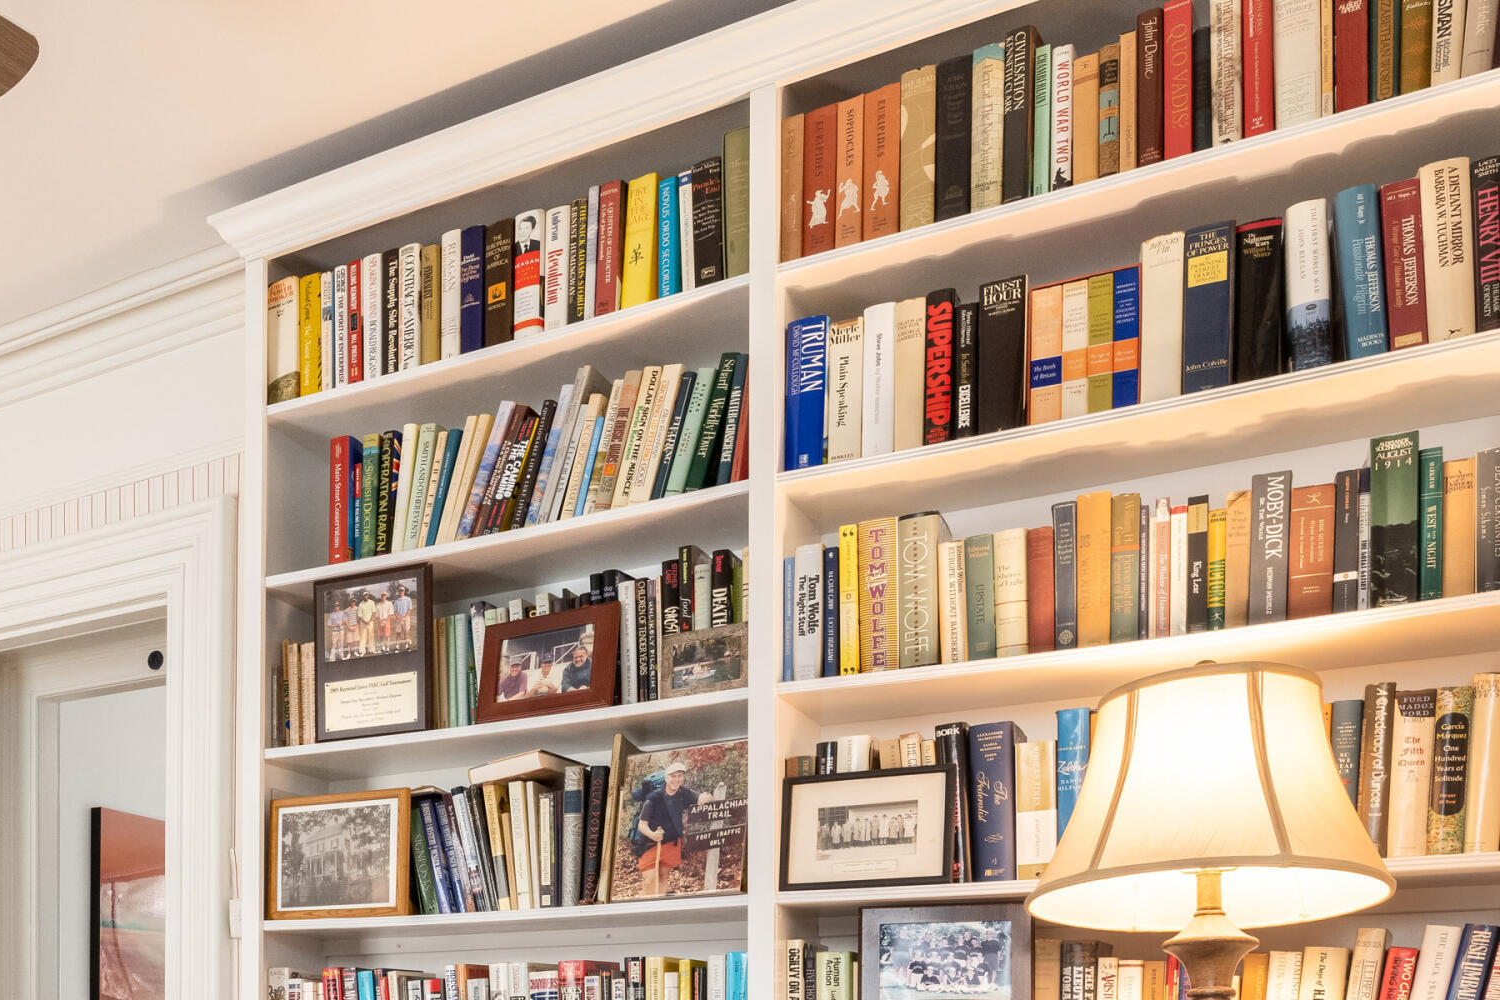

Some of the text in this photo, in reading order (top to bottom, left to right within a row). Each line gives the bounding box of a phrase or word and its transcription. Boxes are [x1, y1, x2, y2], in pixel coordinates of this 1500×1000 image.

[1141, 16, 1158, 80] John Donne
[1004, 36, 1014, 114] KENNETH CLARK
[1013, 31, 1026, 111] CIVILISATION
[1165, 23, 1189, 129] QUO VADIS?
[1055, 60, 1070, 164] WORLD WAR TWO
[845, 108, 855, 168] SOPHOCLES
[1434, 168, 1446, 213] BARBARA
[1198, 231, 1218, 240] THE
[1447, 166, 1463, 266] A DISTANT MIRROR
[577, 204, 587, 317] THE NICK ADAMS STORIES
[660, 185, 670, 297] NOVUS ORDO SECLORUM
[1186, 242, 1229, 257] OF POWER
[1189, 235, 1227, 249] FRINGES
[1401, 215, 1419, 306] THOMAS JEFFERSON
[1436, 221, 1450, 268] TUCHMAN
[983, 278, 1023, 296] FINEST
[1364, 235, 1381, 312] THOMAS JEFFERSON
[387, 259, 398, 373] The Supply-Side Revolution
[983, 288, 1022, 306] HOUR
[829, 333, 861, 347] Miller
[830, 325, 861, 337] Merle
[800, 320, 825, 393] TRUMAN
[926, 301, 953, 426] SUPERSHIP
[1186, 357, 1228, 372] John Colville
[836, 355, 850, 428] Plain Speaking
[621, 370, 659, 497] DOLLAR SIGN ON THE MUSCLE
[1376, 448, 1413, 460] AUGUST
[503, 439, 529, 498] THE CAMINO
[334, 463, 343, 549] Main Street Conservatism
[377, 443, 391, 551] OPERATION RAVEN
[1264, 474, 1285, 560] MOBY-DICK
[712, 587, 728, 628] DEATH
[796, 575, 807, 637] The Right Stuff
[807, 574, 820, 635] Tom Wolfe
[868, 528, 886, 668] TOM WOLFE
[902, 530, 929, 655] TOM WOLFE
[638, 580, 648, 676] CHILDREN OF TENDER YEARS
[1399, 702, 1434, 711] MADOX
[1401, 709, 1430, 717] FORD
[1403, 695, 1431, 703] FORD
[936, 726, 960, 738] BORK
[1436, 731, 1467, 740] Márquez
[1440, 722, 1465, 730] García
[1434, 754, 1466, 762] Hundred
[1436, 764, 1455, 772] Years
[1443, 745, 1459, 753] One
[691, 798, 748, 814] APPALACHIAN
[707, 810, 732, 820] TRAIL
[975, 770, 1008, 824] The Federalist
[695, 832, 712, 841] FOOT
[709, 838, 726, 847] ONLY
[788, 948, 800, 978] OGILVY
[1467, 930, 1492, 961] RUSH
[788, 980, 800, 995] ON
[833, 957, 842, 987] Human
[1388, 956, 1402, 987] IRVING
[1400, 956, 1415, 981] TWO
